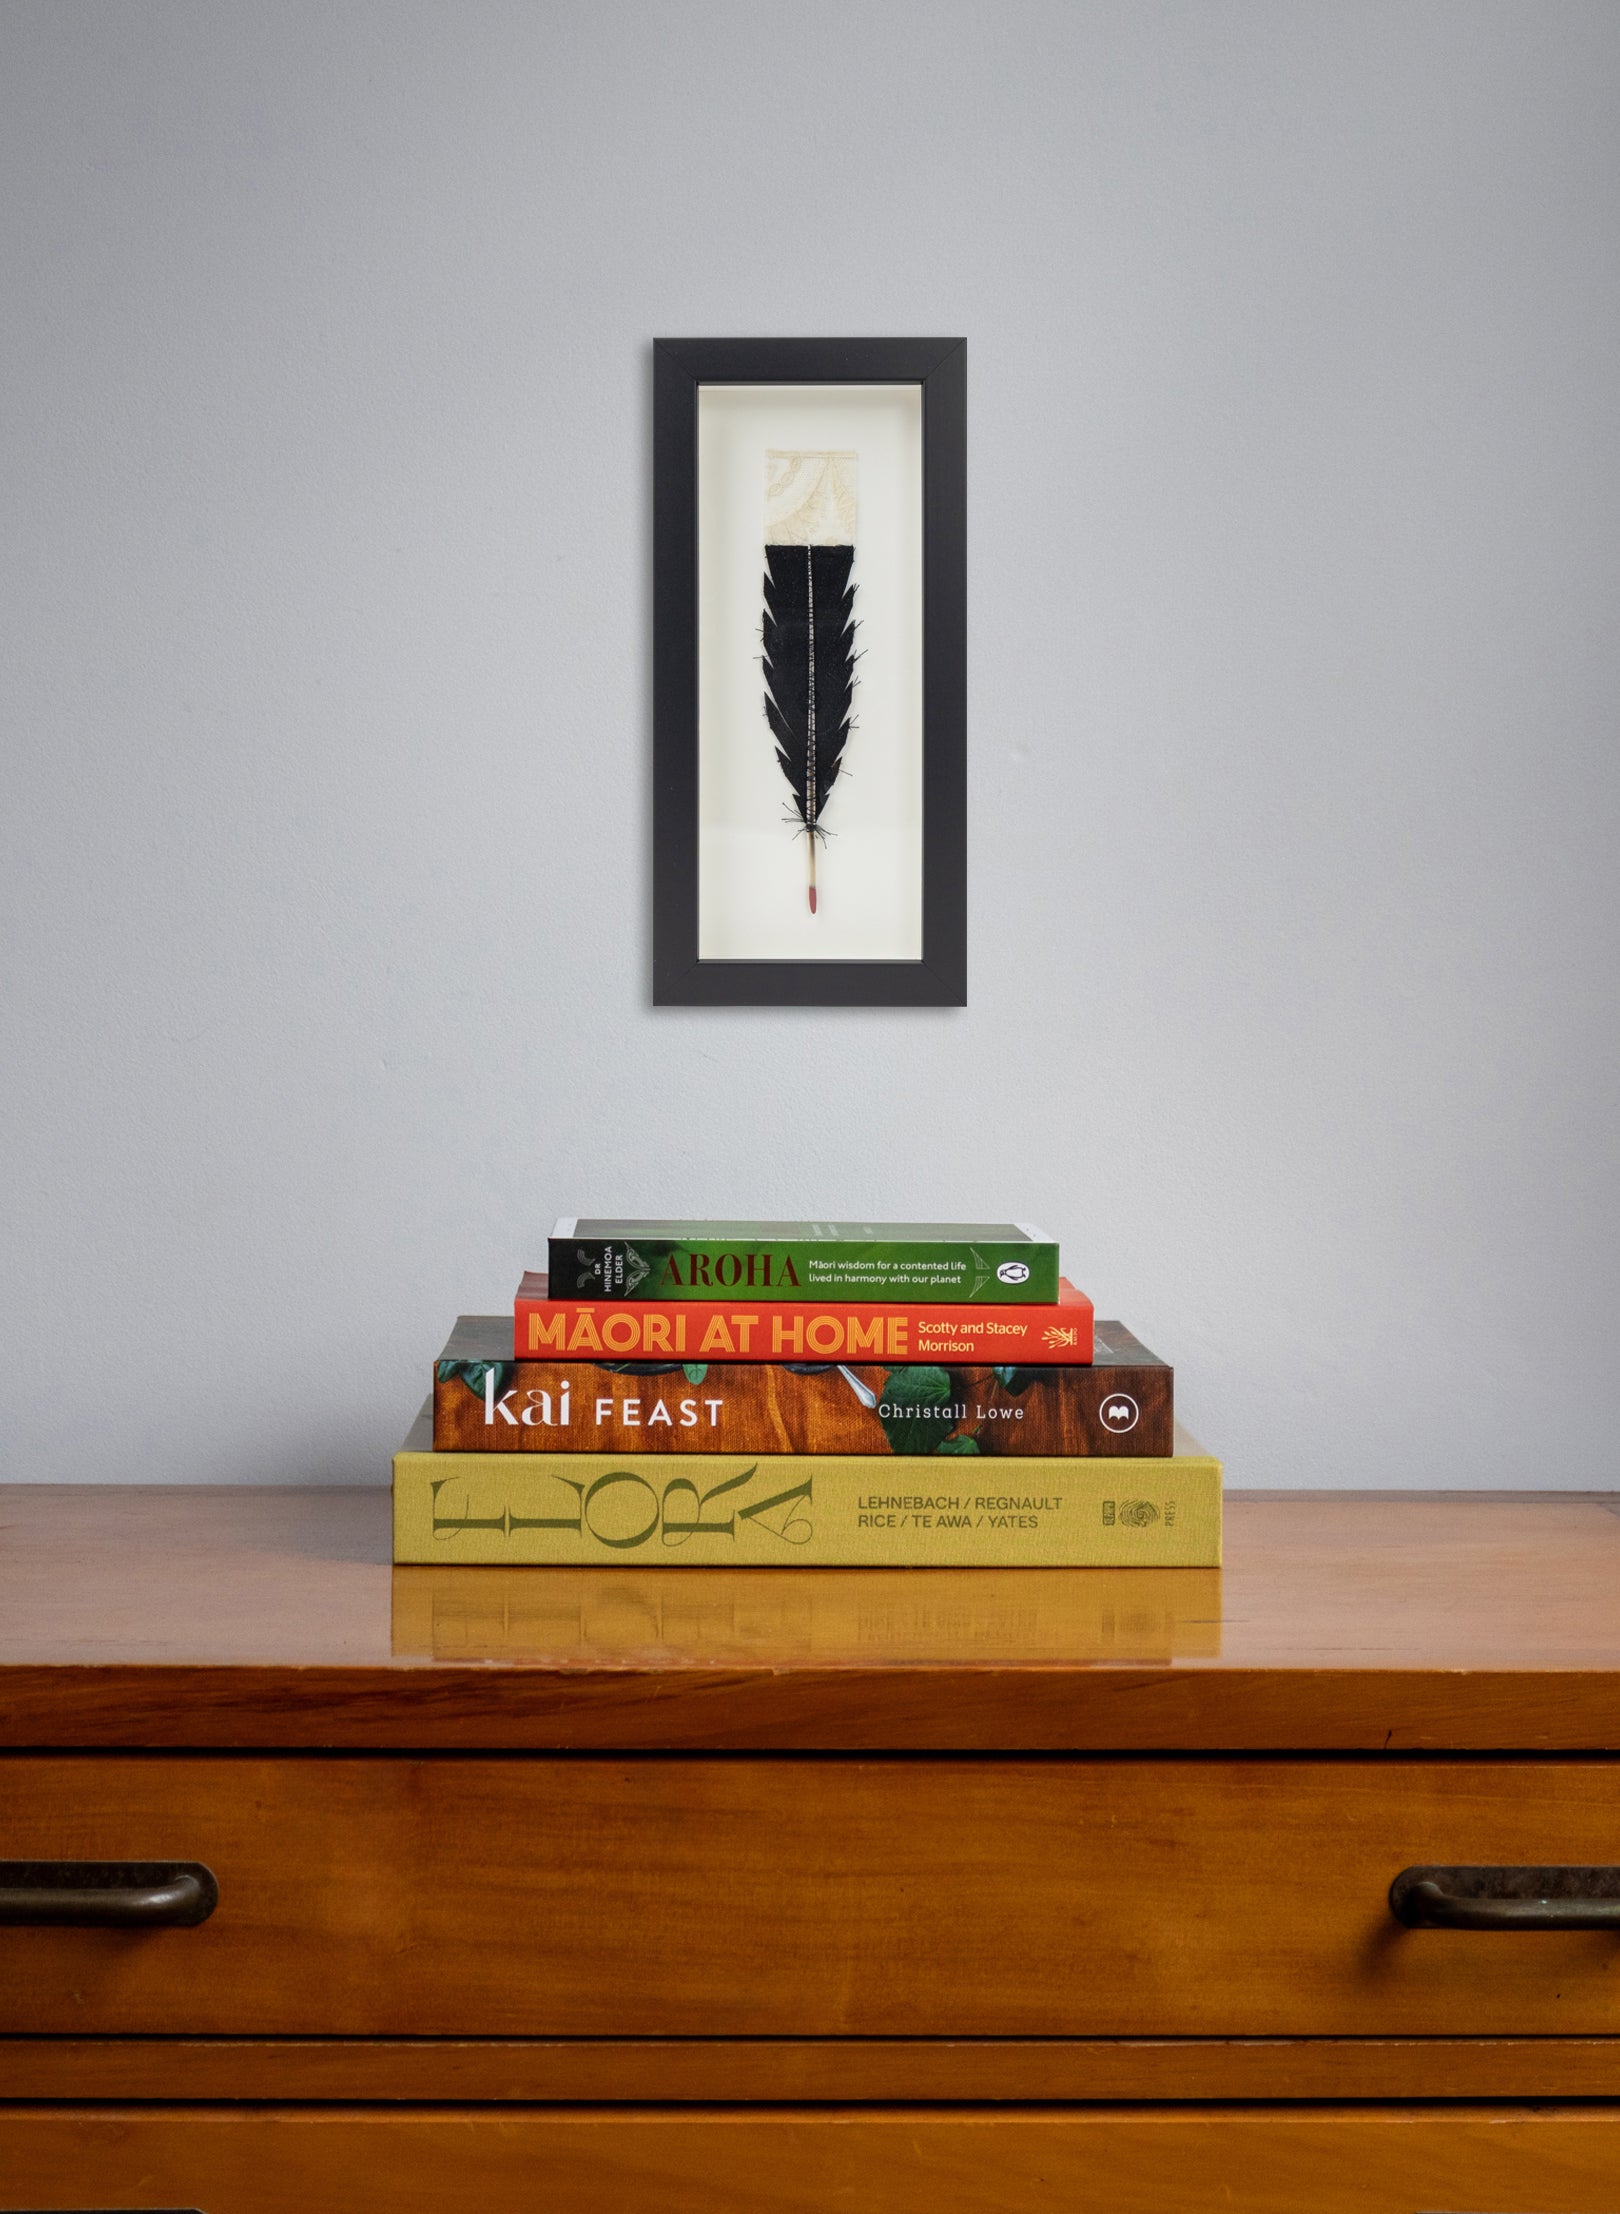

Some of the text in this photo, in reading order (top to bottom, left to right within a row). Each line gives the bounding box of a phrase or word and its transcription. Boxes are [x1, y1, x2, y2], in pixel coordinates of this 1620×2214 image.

[594, 1263, 601, 1275] DR
[604, 1246, 613, 1292] HINEMOA
[615, 1254, 623, 1284] ELDER
[660, 1253, 801, 1287] AROHA
[838, 1260, 875, 1270] wisdom
[877, 1260, 891, 1270] for
[900, 1261, 949, 1271] contented
[951, 1261, 967, 1271] life
[809, 1273, 832, 1282] lived
[834, 1274, 843, 1282] in
[845, 1274, 886, 1285] harmony
[889, 1274, 910, 1283] with
[930, 1275, 961, 1285] planet
[528, 1307, 908, 1354] MĀORI AT HOME
[918, 1321, 1028, 1337] Scotty and Stacey
[918, 1339, 975, 1352] Morrison
[484, 1367, 724, 1427] kai FEAST
[878, 1404, 1025, 1420] Christall Lowe
[430, 1462, 814, 1550] FLORA
[858, 1496, 960, 1510] LEHNEBACH
[974, 1496, 1063, 1511] REGNAULT
[858, 1514, 897, 1529] RICE
[911, 1515, 932, 1529] TE
[935, 1515, 972, 1529] AWA
[987, 1515, 1039, 1530] YATES
[1164, 1501, 1176, 1527] PRESS
